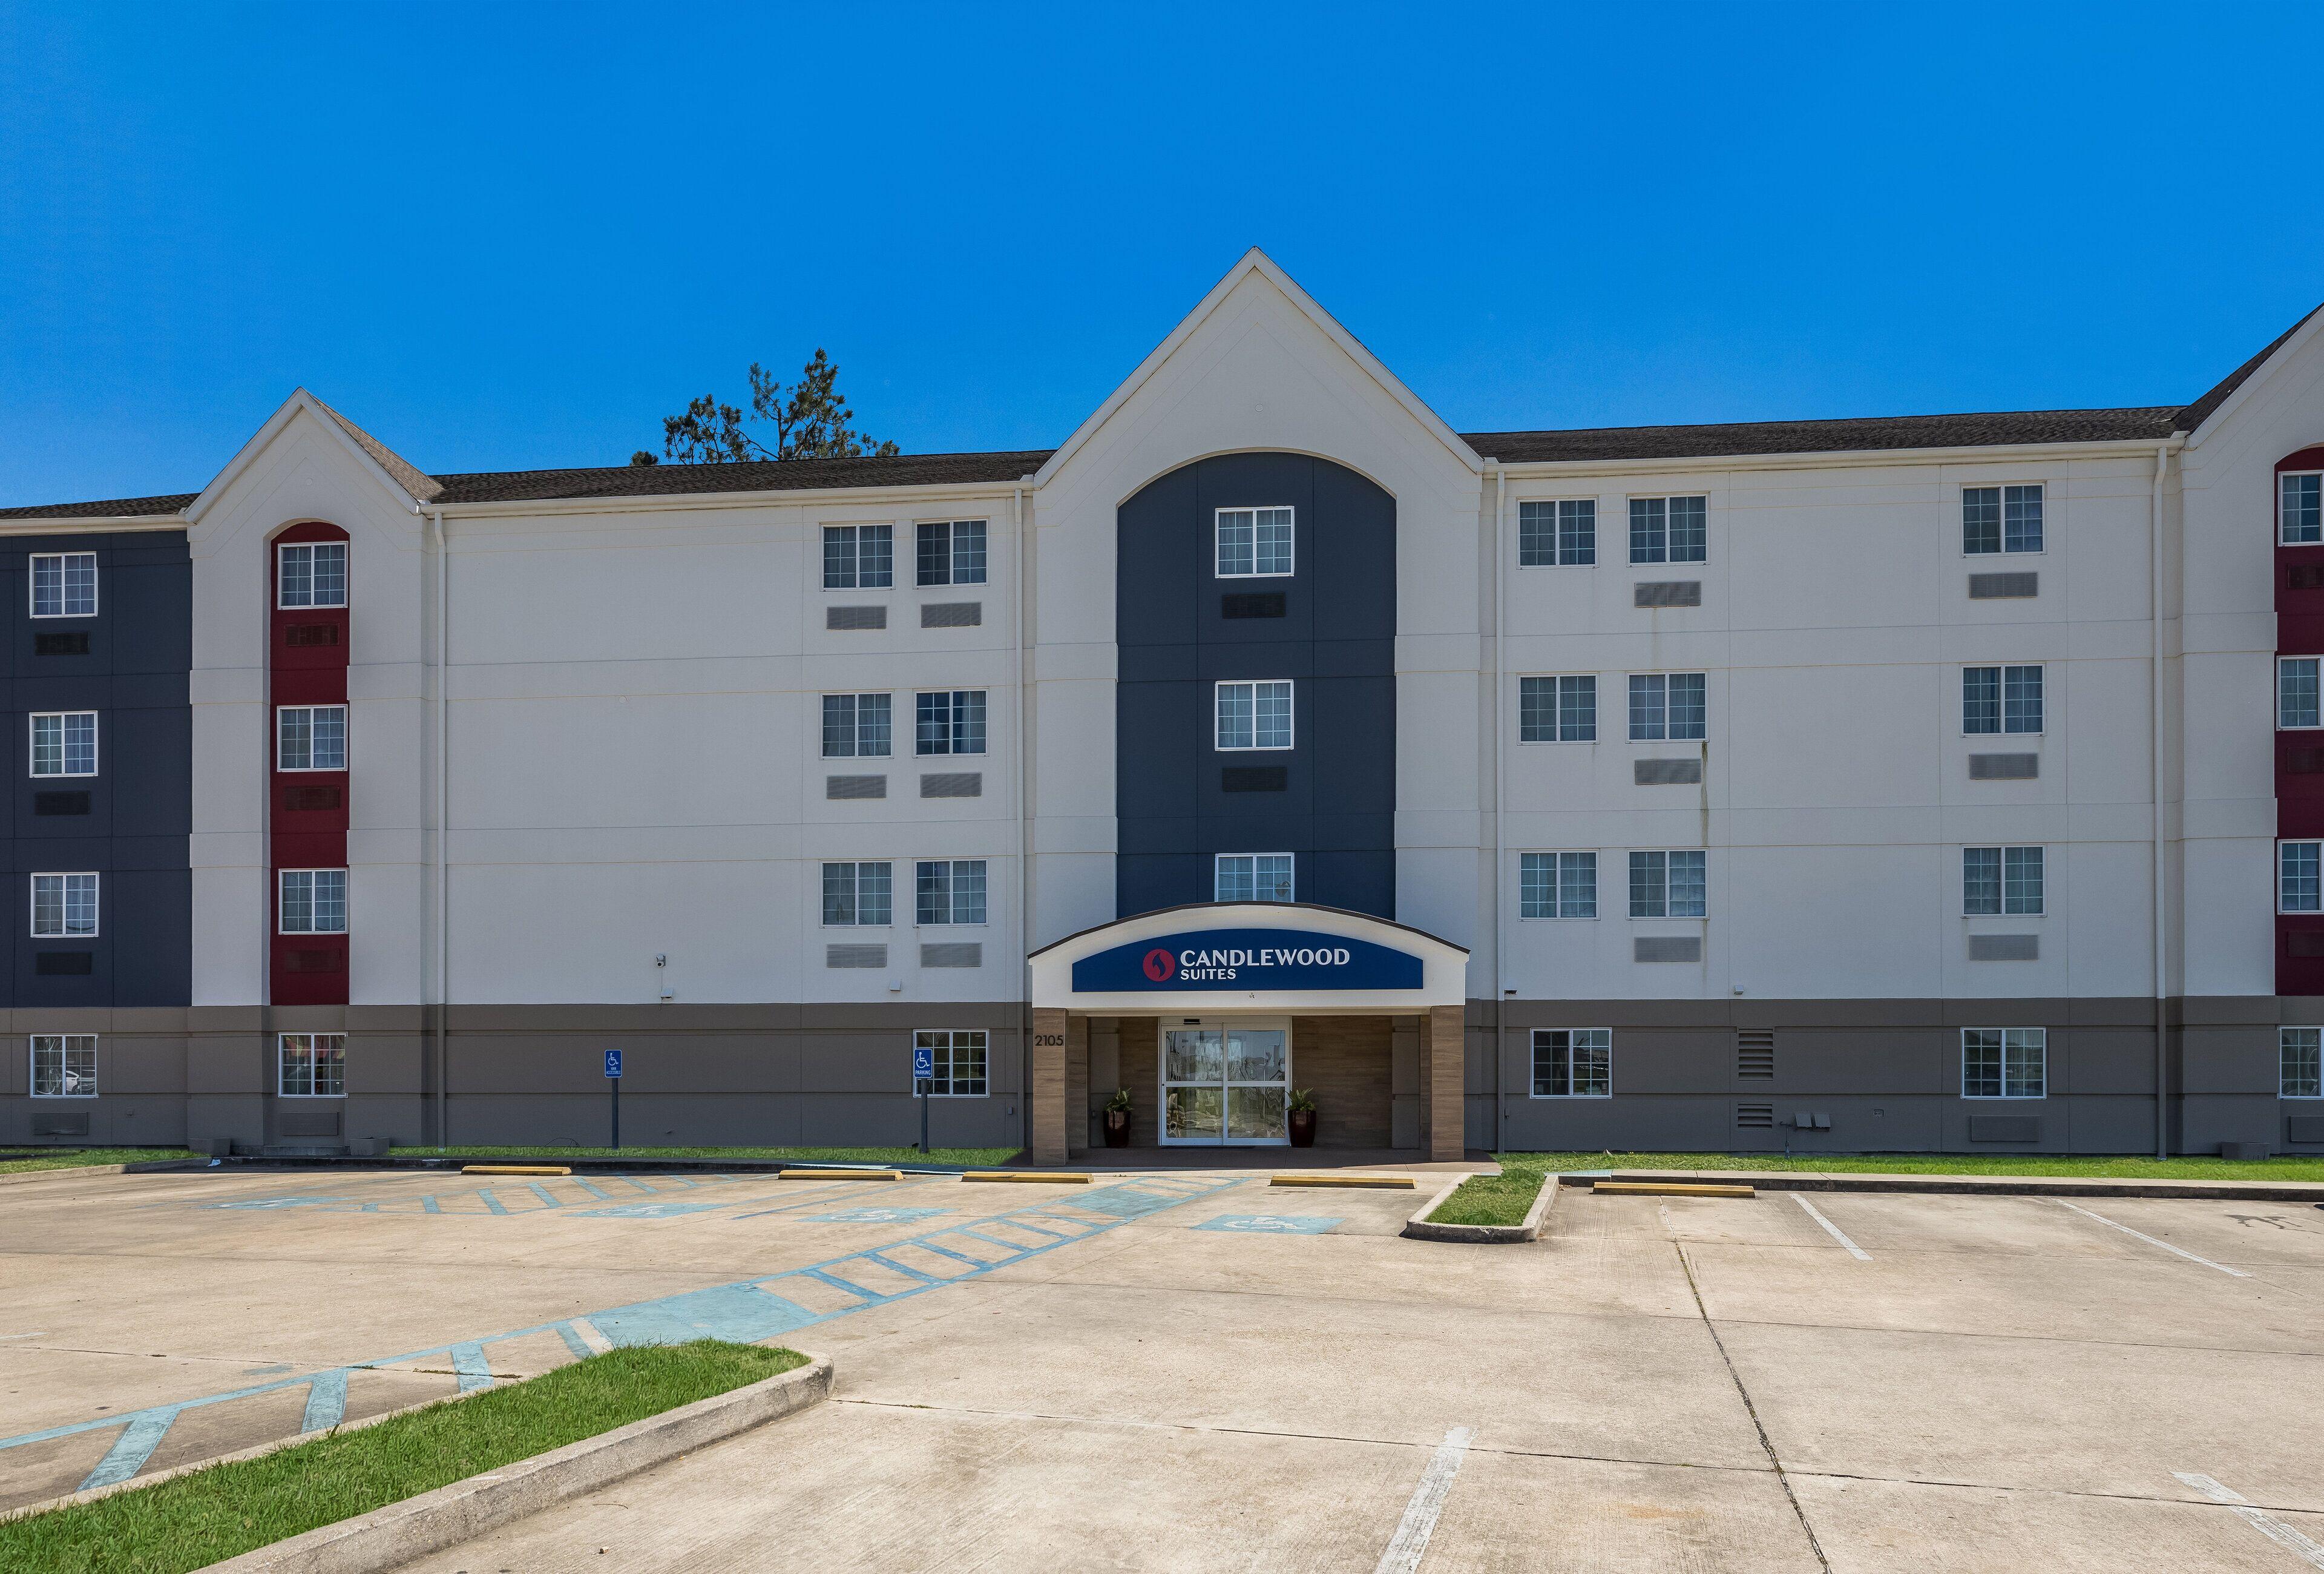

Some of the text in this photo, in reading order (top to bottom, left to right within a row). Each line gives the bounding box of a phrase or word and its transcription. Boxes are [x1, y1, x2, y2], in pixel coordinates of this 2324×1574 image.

[1180, 949, 1350, 967] CANDLEWOOD
[1180, 969, 1236, 980] SUITES
[1035, 1035, 1063, 1046] 2105
